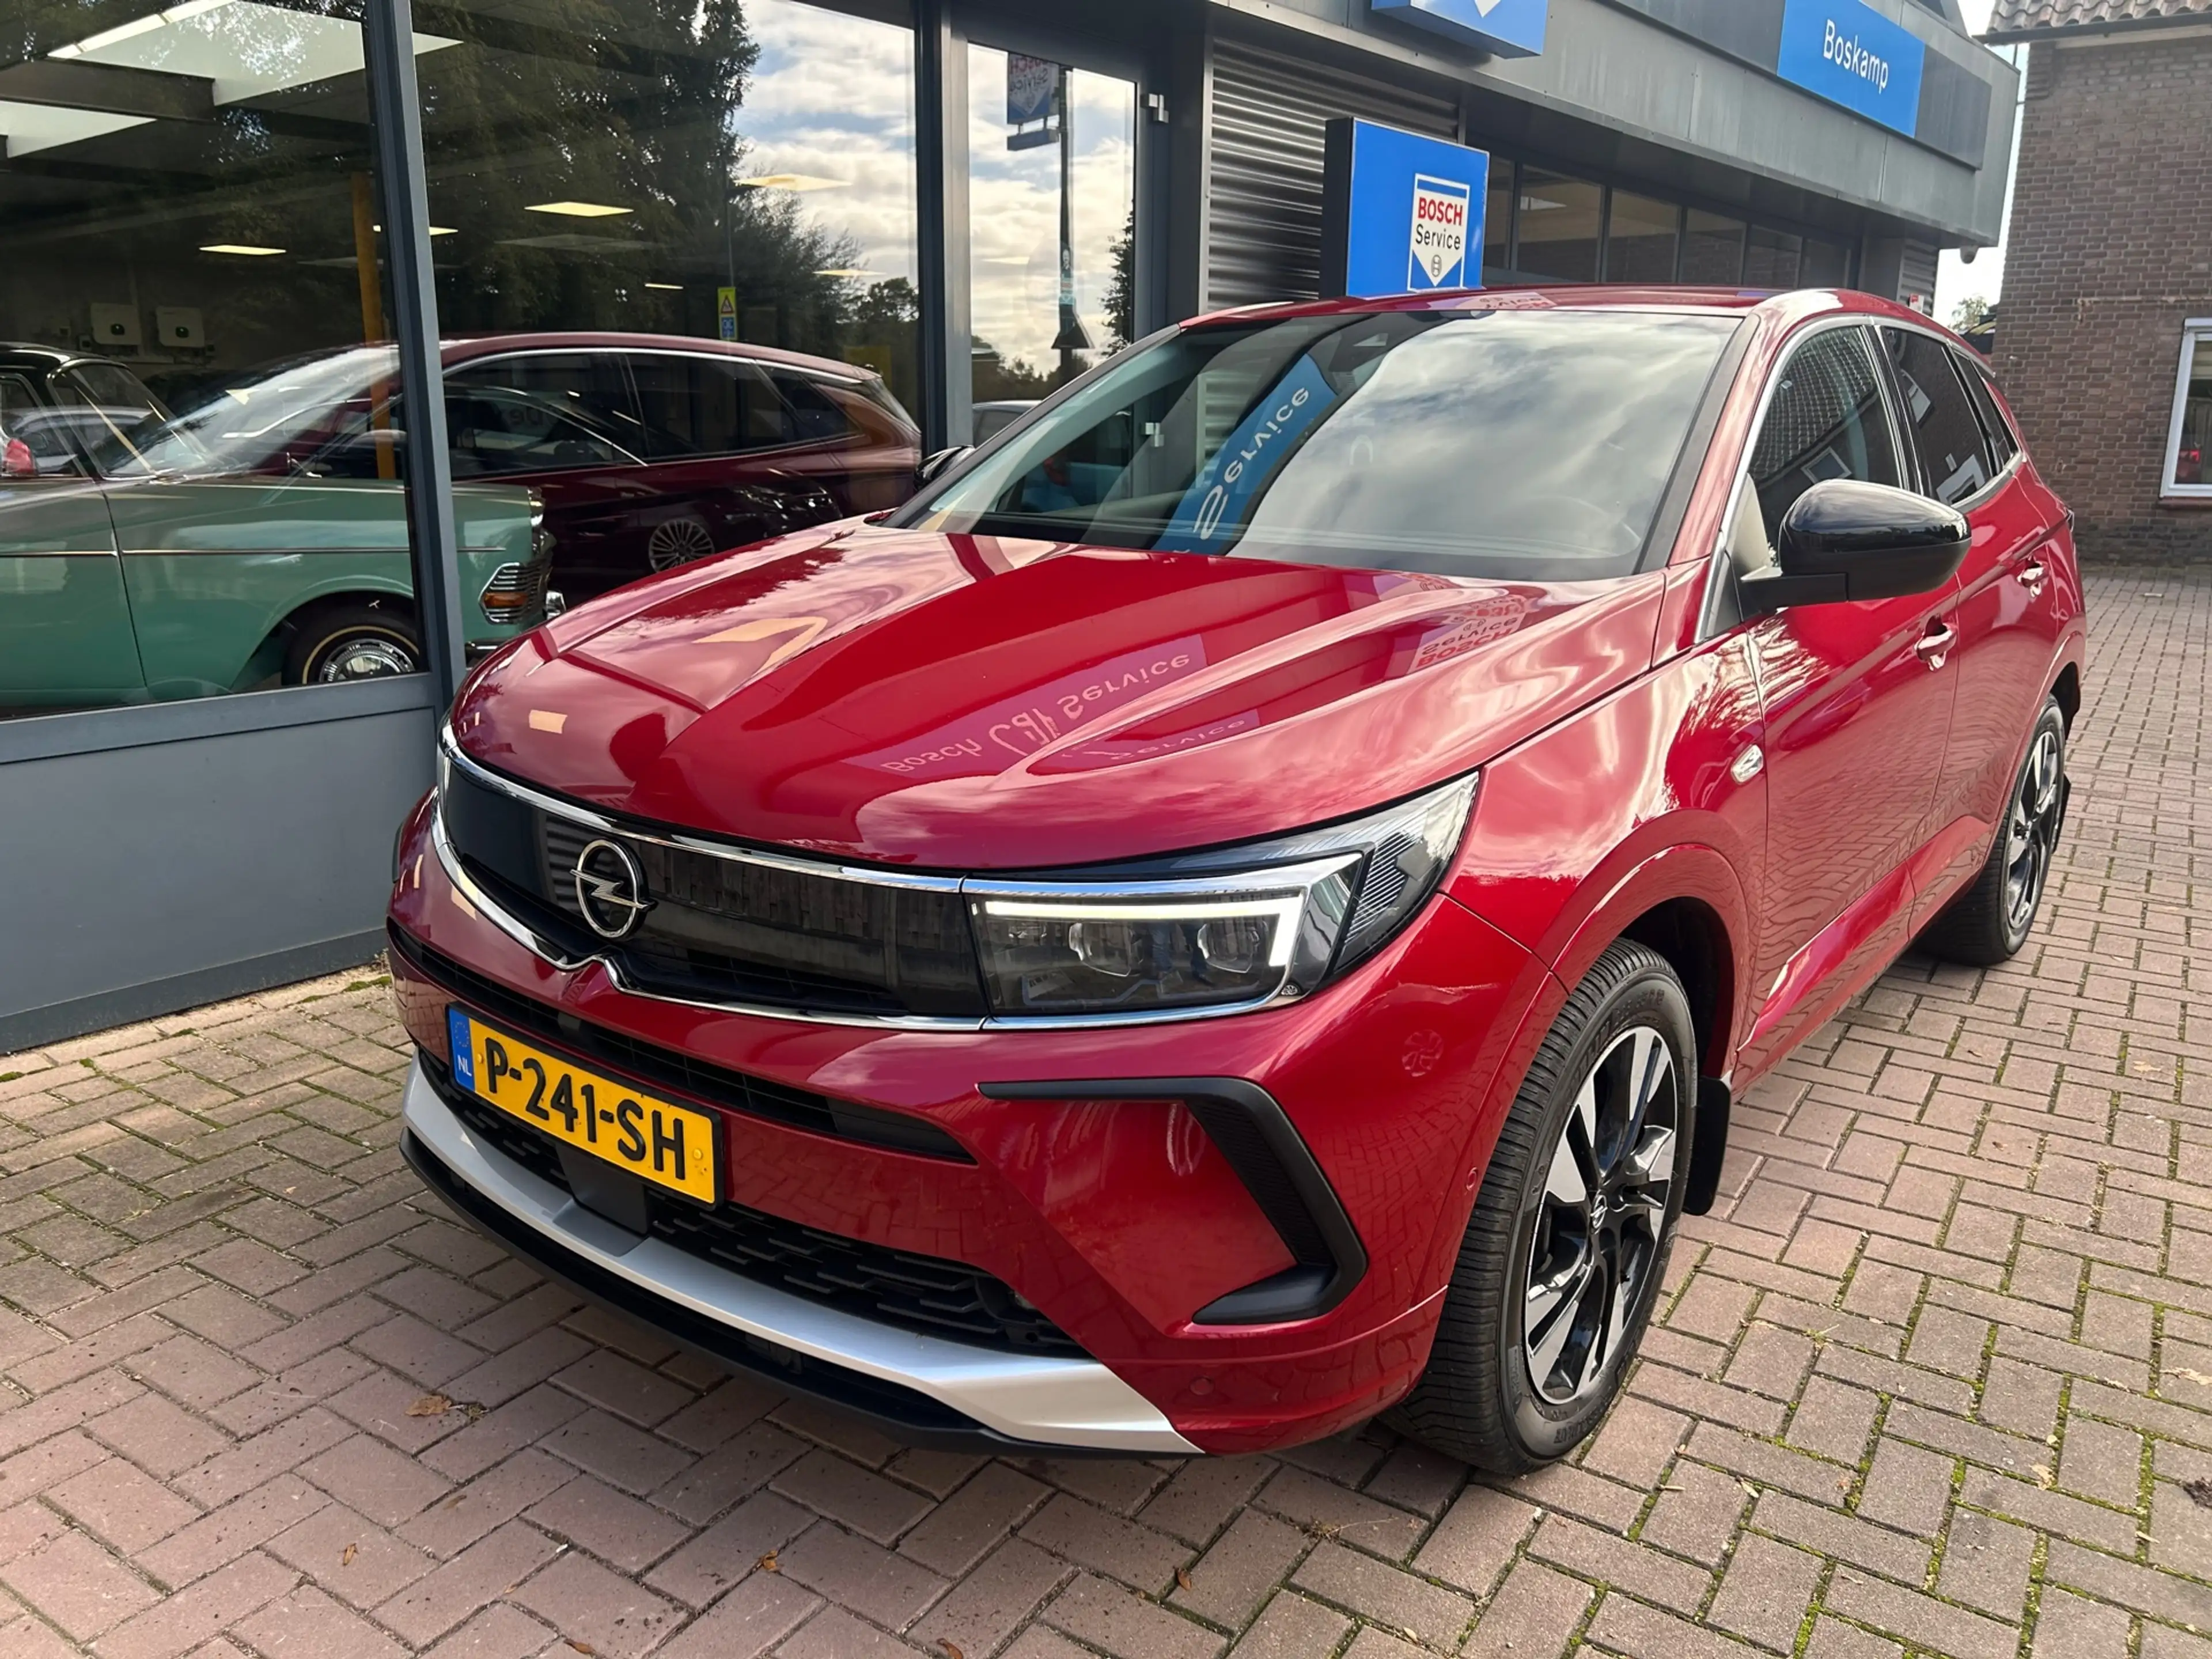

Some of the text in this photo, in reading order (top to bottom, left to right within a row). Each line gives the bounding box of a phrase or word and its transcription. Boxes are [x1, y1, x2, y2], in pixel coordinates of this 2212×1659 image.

[1823, 18, 1888, 94] Boskamp
[1415, 224, 1461, 250] Service
[1418, 196, 1463, 226] BOSCH
[457, 1037, 685, 1180] NL P-241-SH
